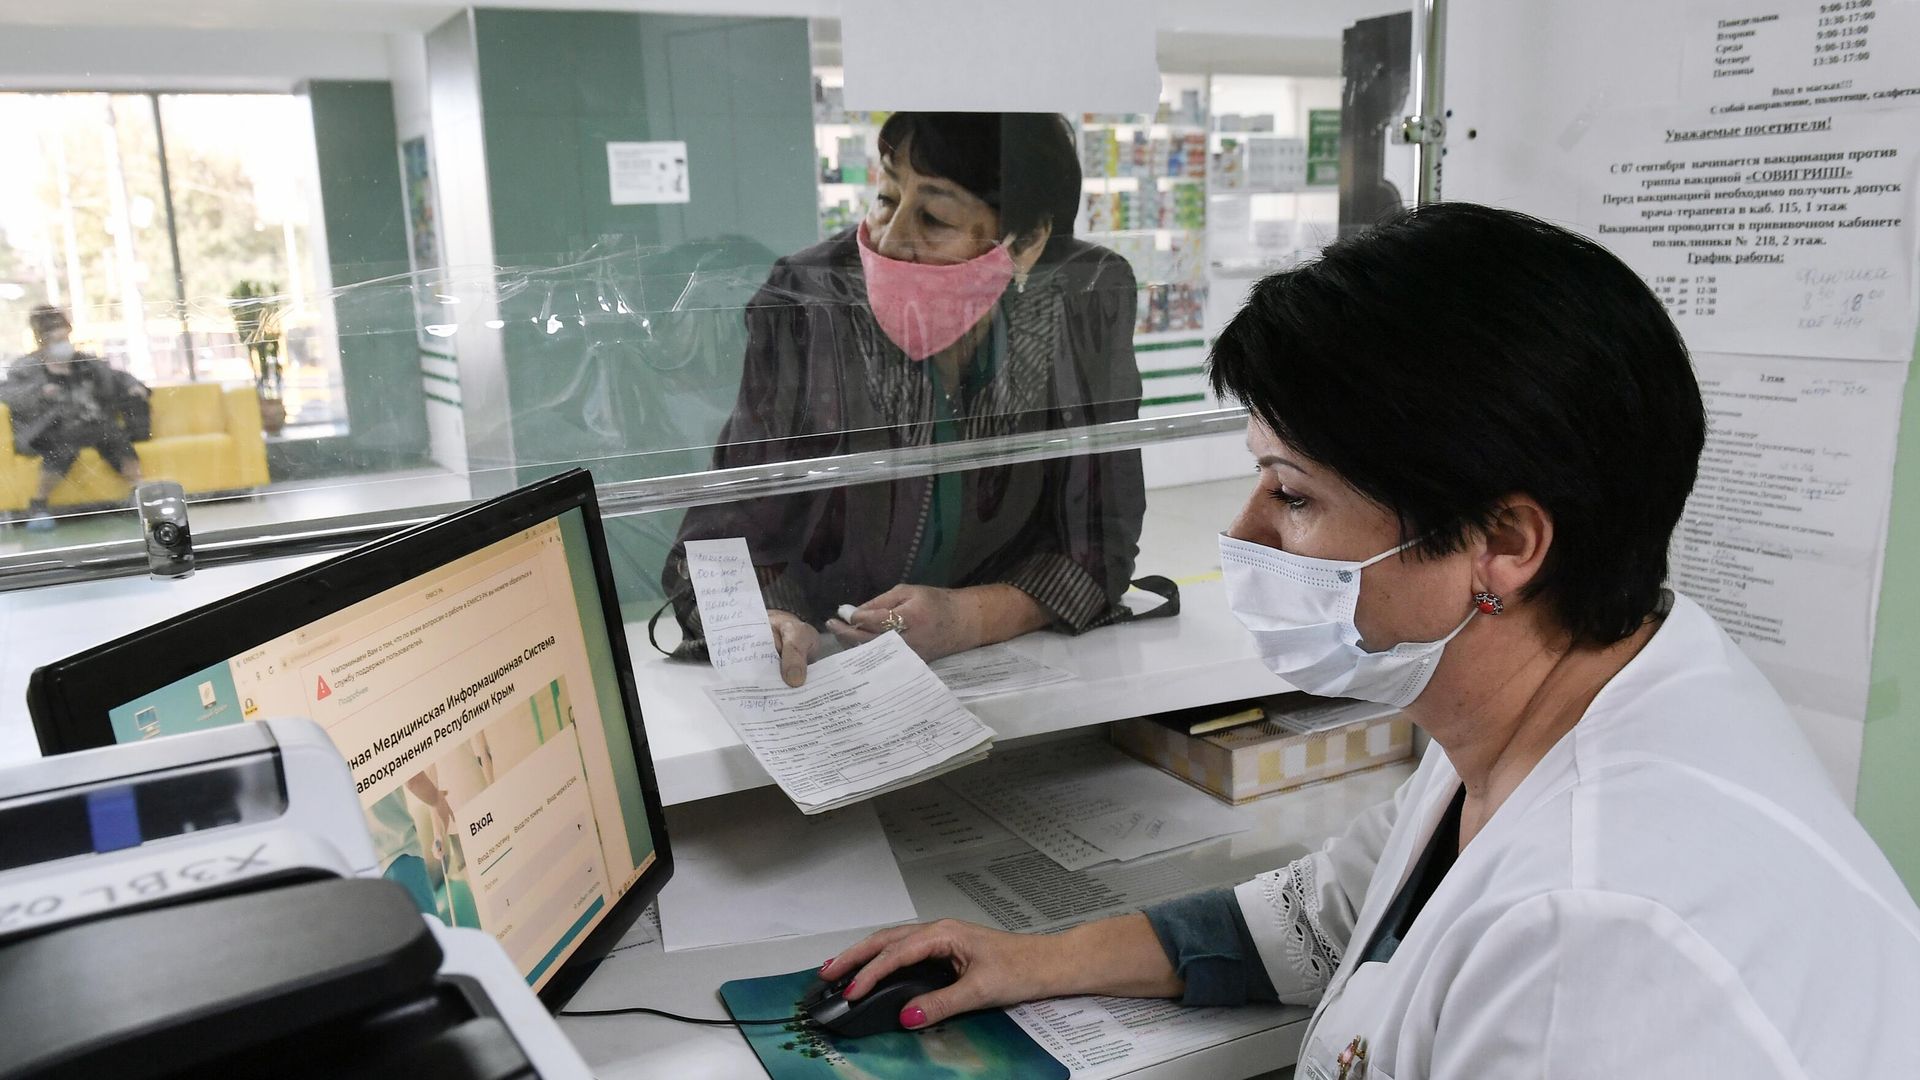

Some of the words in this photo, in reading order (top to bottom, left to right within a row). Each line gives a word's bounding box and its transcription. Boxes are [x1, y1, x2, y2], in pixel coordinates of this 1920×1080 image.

[1665, 126, 1741, 143] Уважаемые
[1744, 116, 1832, 135] посетители!
[1621, 163, 1633, 173] 07
[1635, 160, 1685, 173] сентября
[1691, 155, 1760, 169] начинается
[1763, 151, 1844, 165] вакцинация
[1848, 148, 1898, 162] против
[1641, 177, 1681, 190] гриппа
[1684, 171, 1741, 185] вакциной
[1602, 194, 1634, 206] Перед
[1637, 189, 1711, 203] вакцинацией
[1714, 185, 1785, 200] необходимо
[1788, 184, 1851, 198] получить
[1853, 182, 1902, 196] допуск
[1738, 206, 1746, 214] в
[1750, 202, 1774, 214] каб.
[1778, 202, 1802, 214] 115,
[1806, 202, 1811, 212] 1
[1816, 202, 1847, 212] этаж
[1598, 224, 1665, 235] Вакцинация
[1668, 222, 1735, 234] проводится
[1738, 222, 1745, 230] в
[1748, 220, 1834, 232] прививочном
[1838, 216, 1902, 229] кабинете
[1652, 236, 1732, 248] поликлиники
[1735, 235, 1748, 247] №
[1754, 235, 1779, 248] 218,
[1782, 235, 1790, 246] 2
[1687, 251, 1732, 265] График
[372, 702, 446, 756] Медицинская
[445, 654, 524, 711] Информационная
[523, 633, 556, 663] Система
[433, 694, 490, 744] Республики
[490, 681, 516, 706] Крым
[469, 811, 494, 837] Вход
